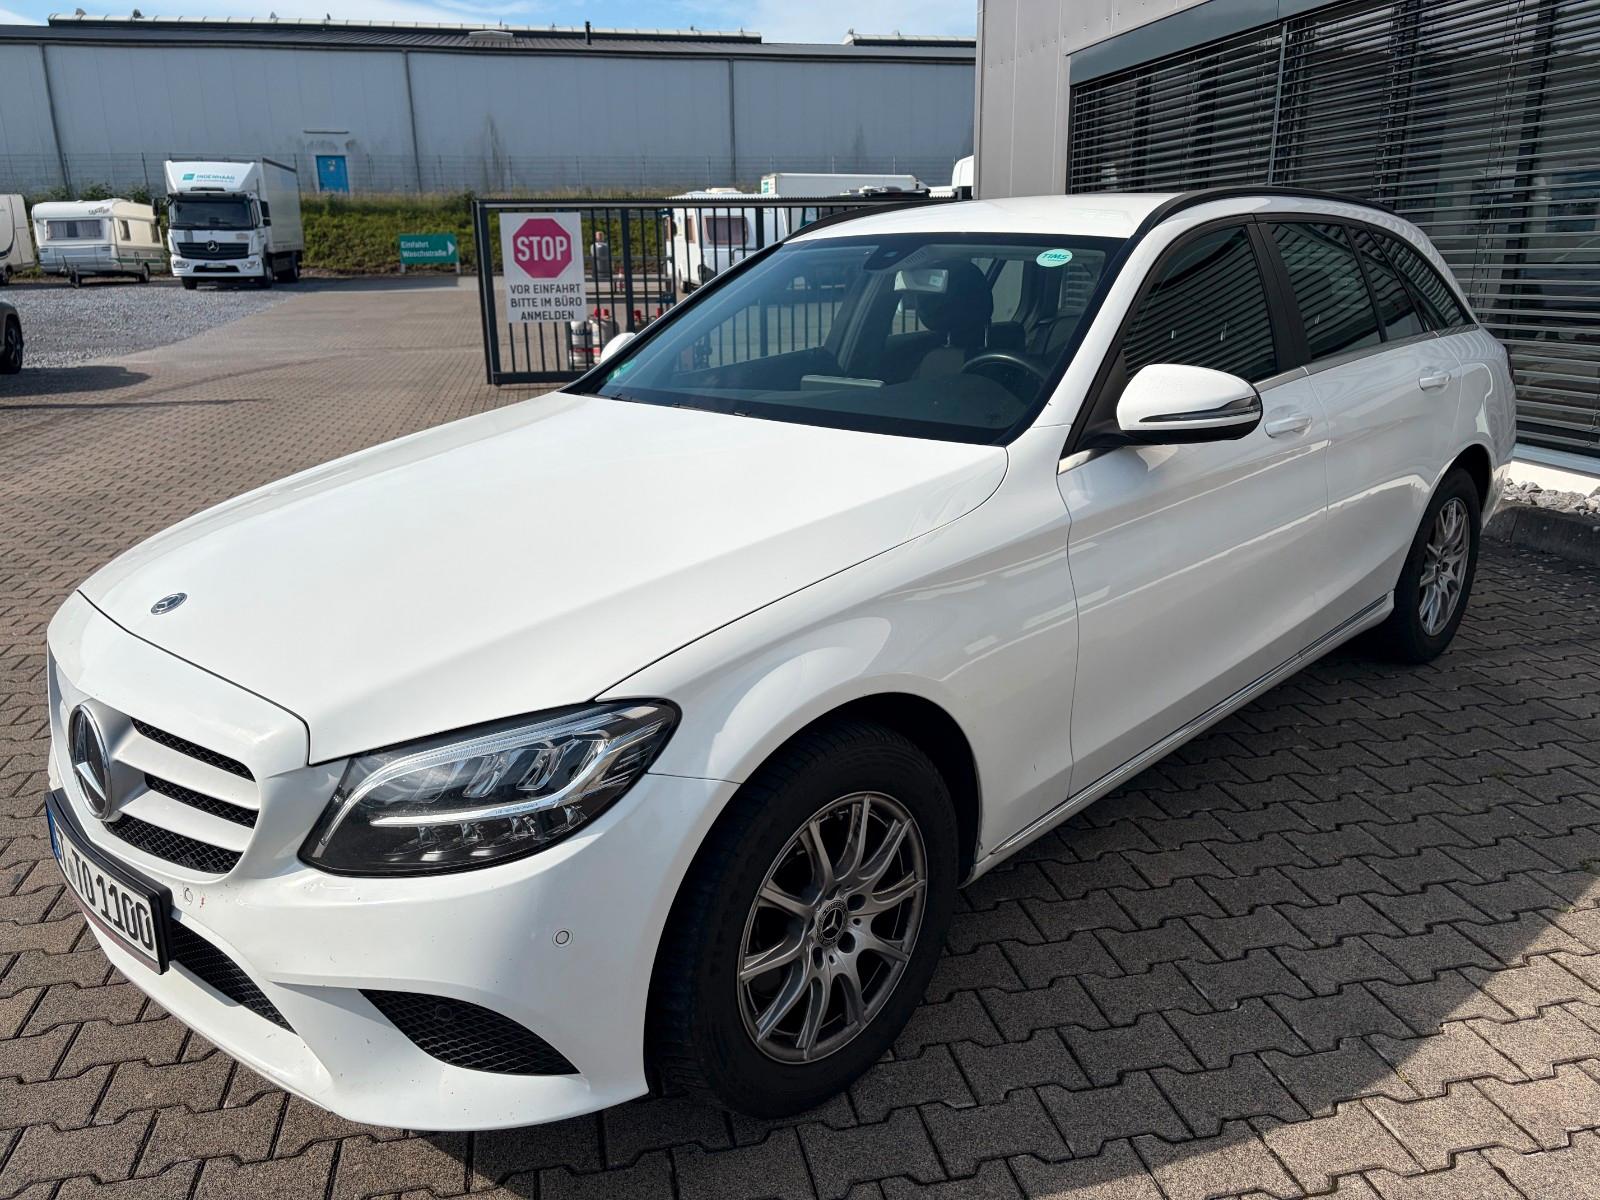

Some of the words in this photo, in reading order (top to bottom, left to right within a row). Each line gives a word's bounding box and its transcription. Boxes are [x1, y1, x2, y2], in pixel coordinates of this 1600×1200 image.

[517, 236, 568, 262] STOP
[510, 284, 530, 294] VOR
[533, 283, 581, 294] EINFAHRT
[511, 298, 538, 308] BITTE
[541, 297, 552, 307] IM
[554, 295, 582, 307] BÜRO
[521, 310, 575, 320] ANMELDEN
[96, 874, 154, 951] 1100
